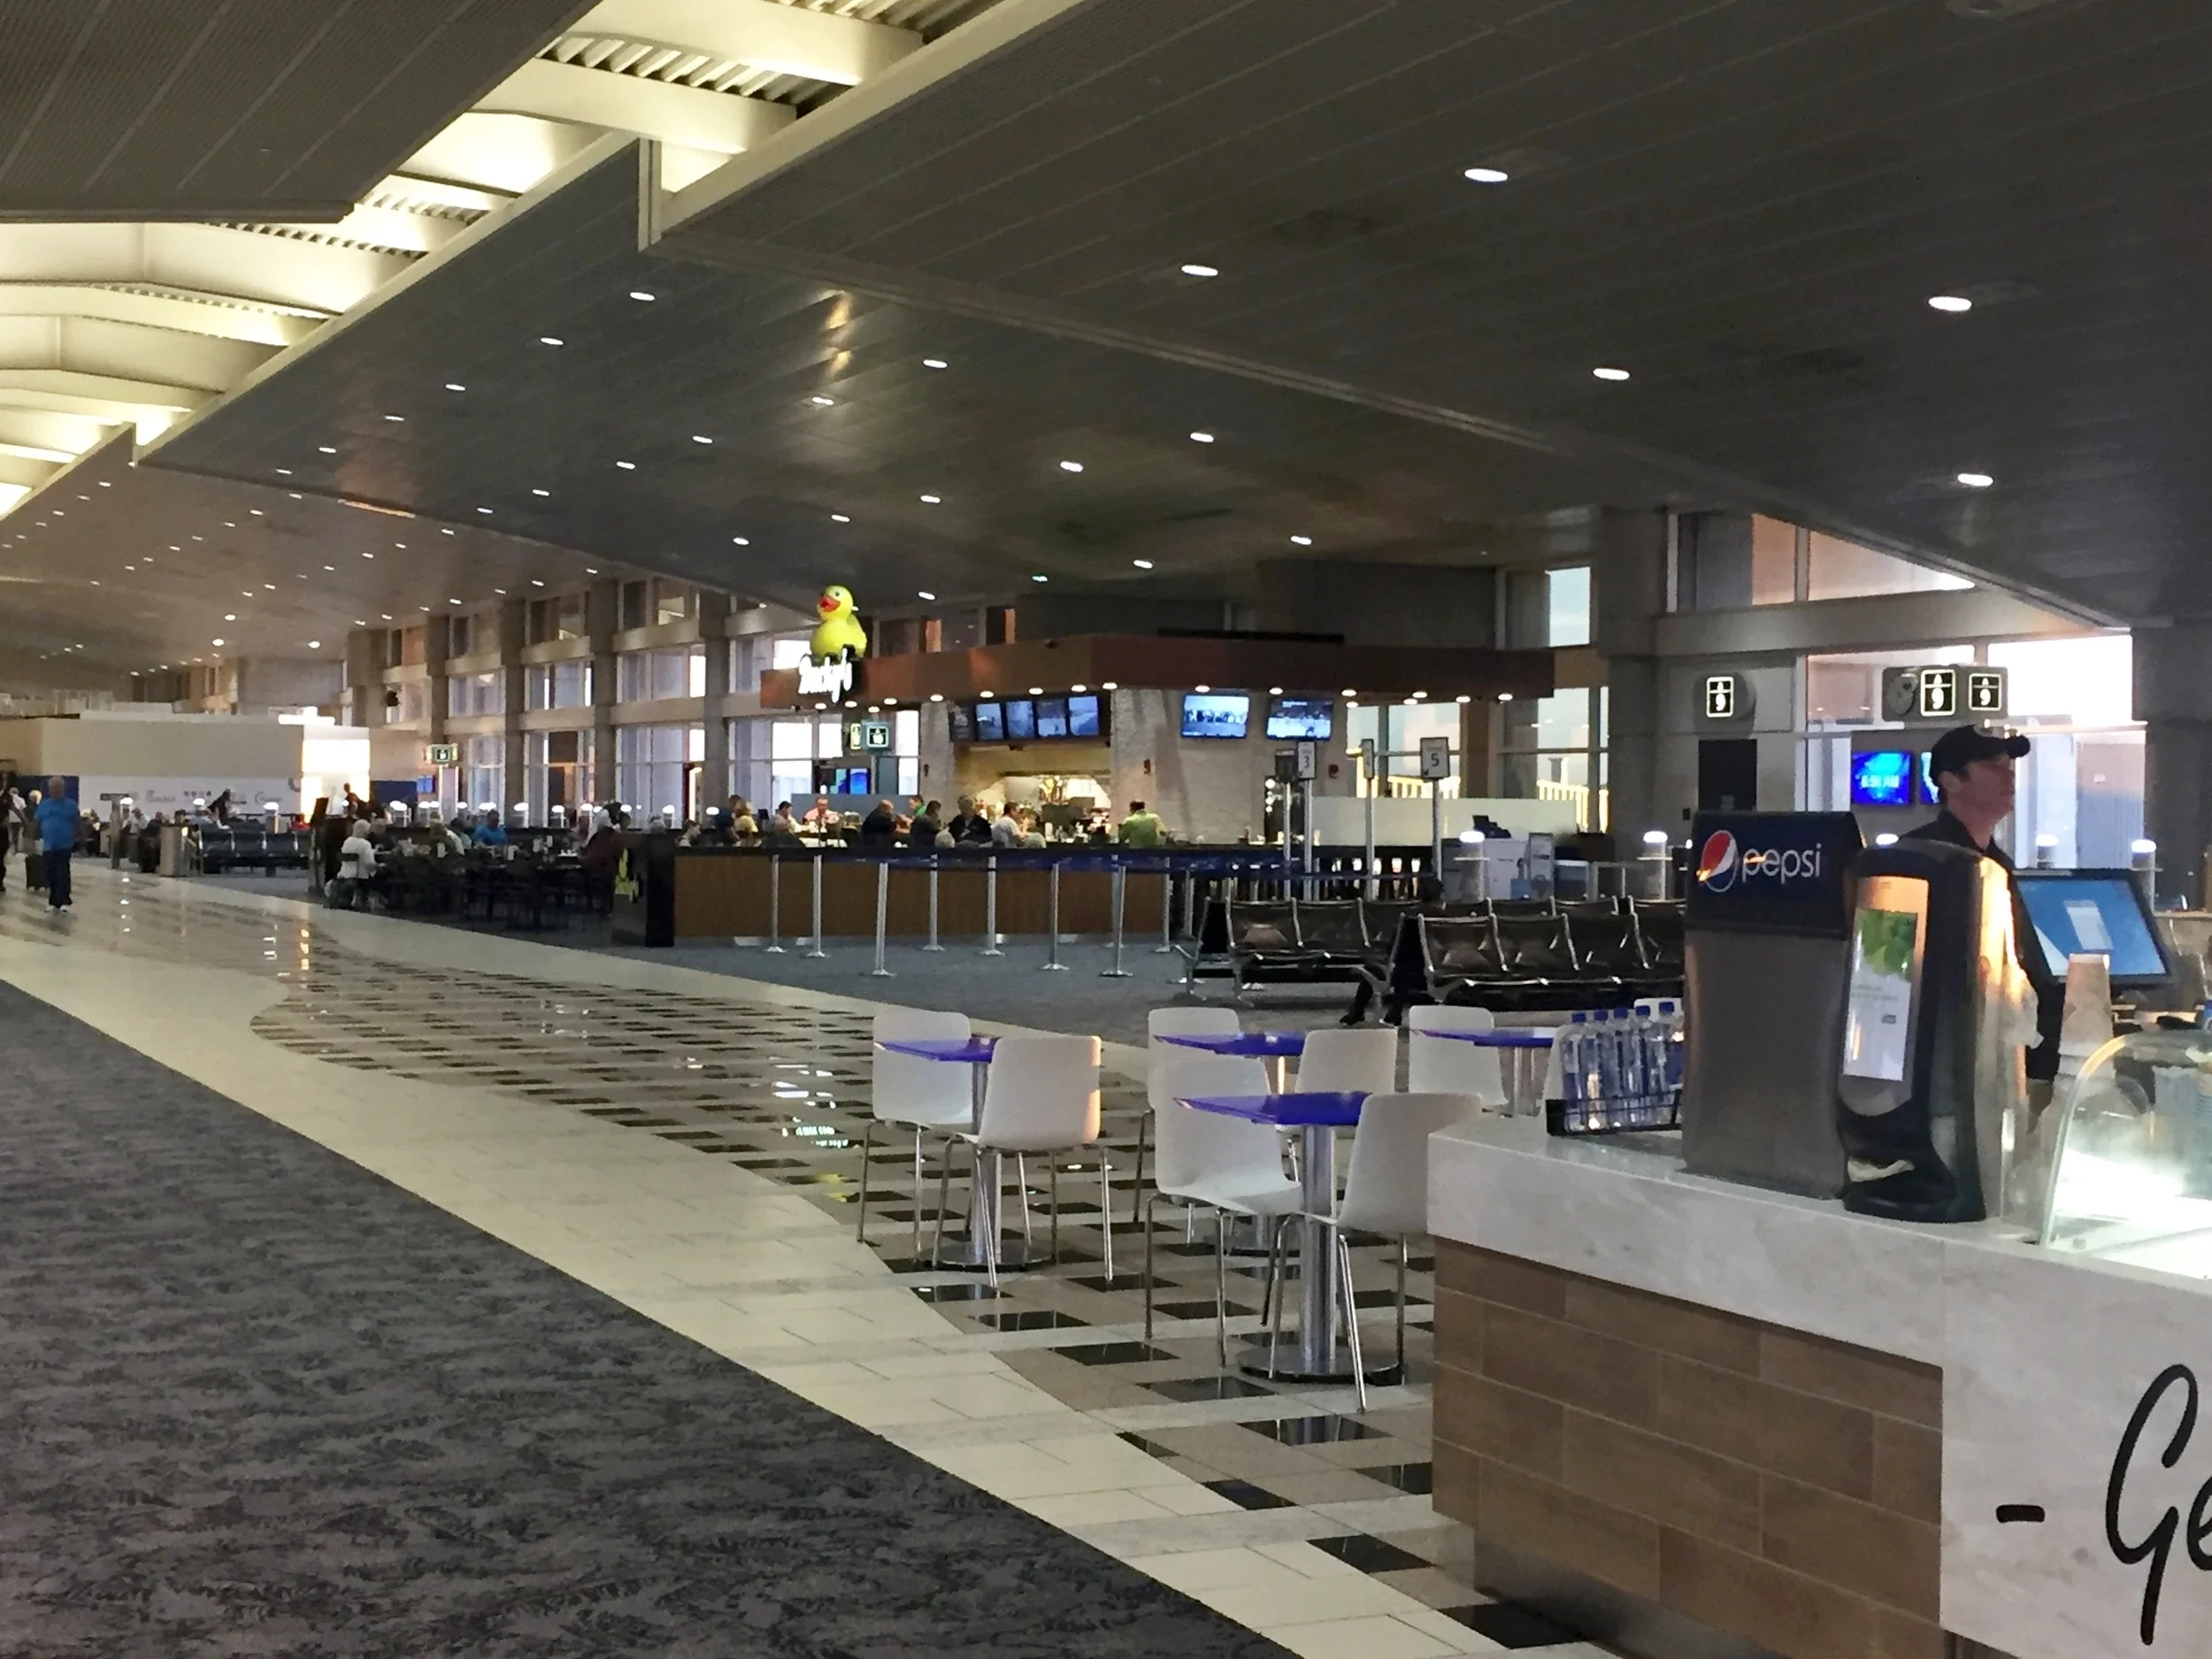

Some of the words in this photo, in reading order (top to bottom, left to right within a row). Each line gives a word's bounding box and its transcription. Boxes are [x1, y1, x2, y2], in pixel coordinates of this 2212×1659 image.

[1303, 755, 1310, 769] 3
[1431, 753, 1440, 767] 5
[1741, 842, 1822, 884] pepsi
